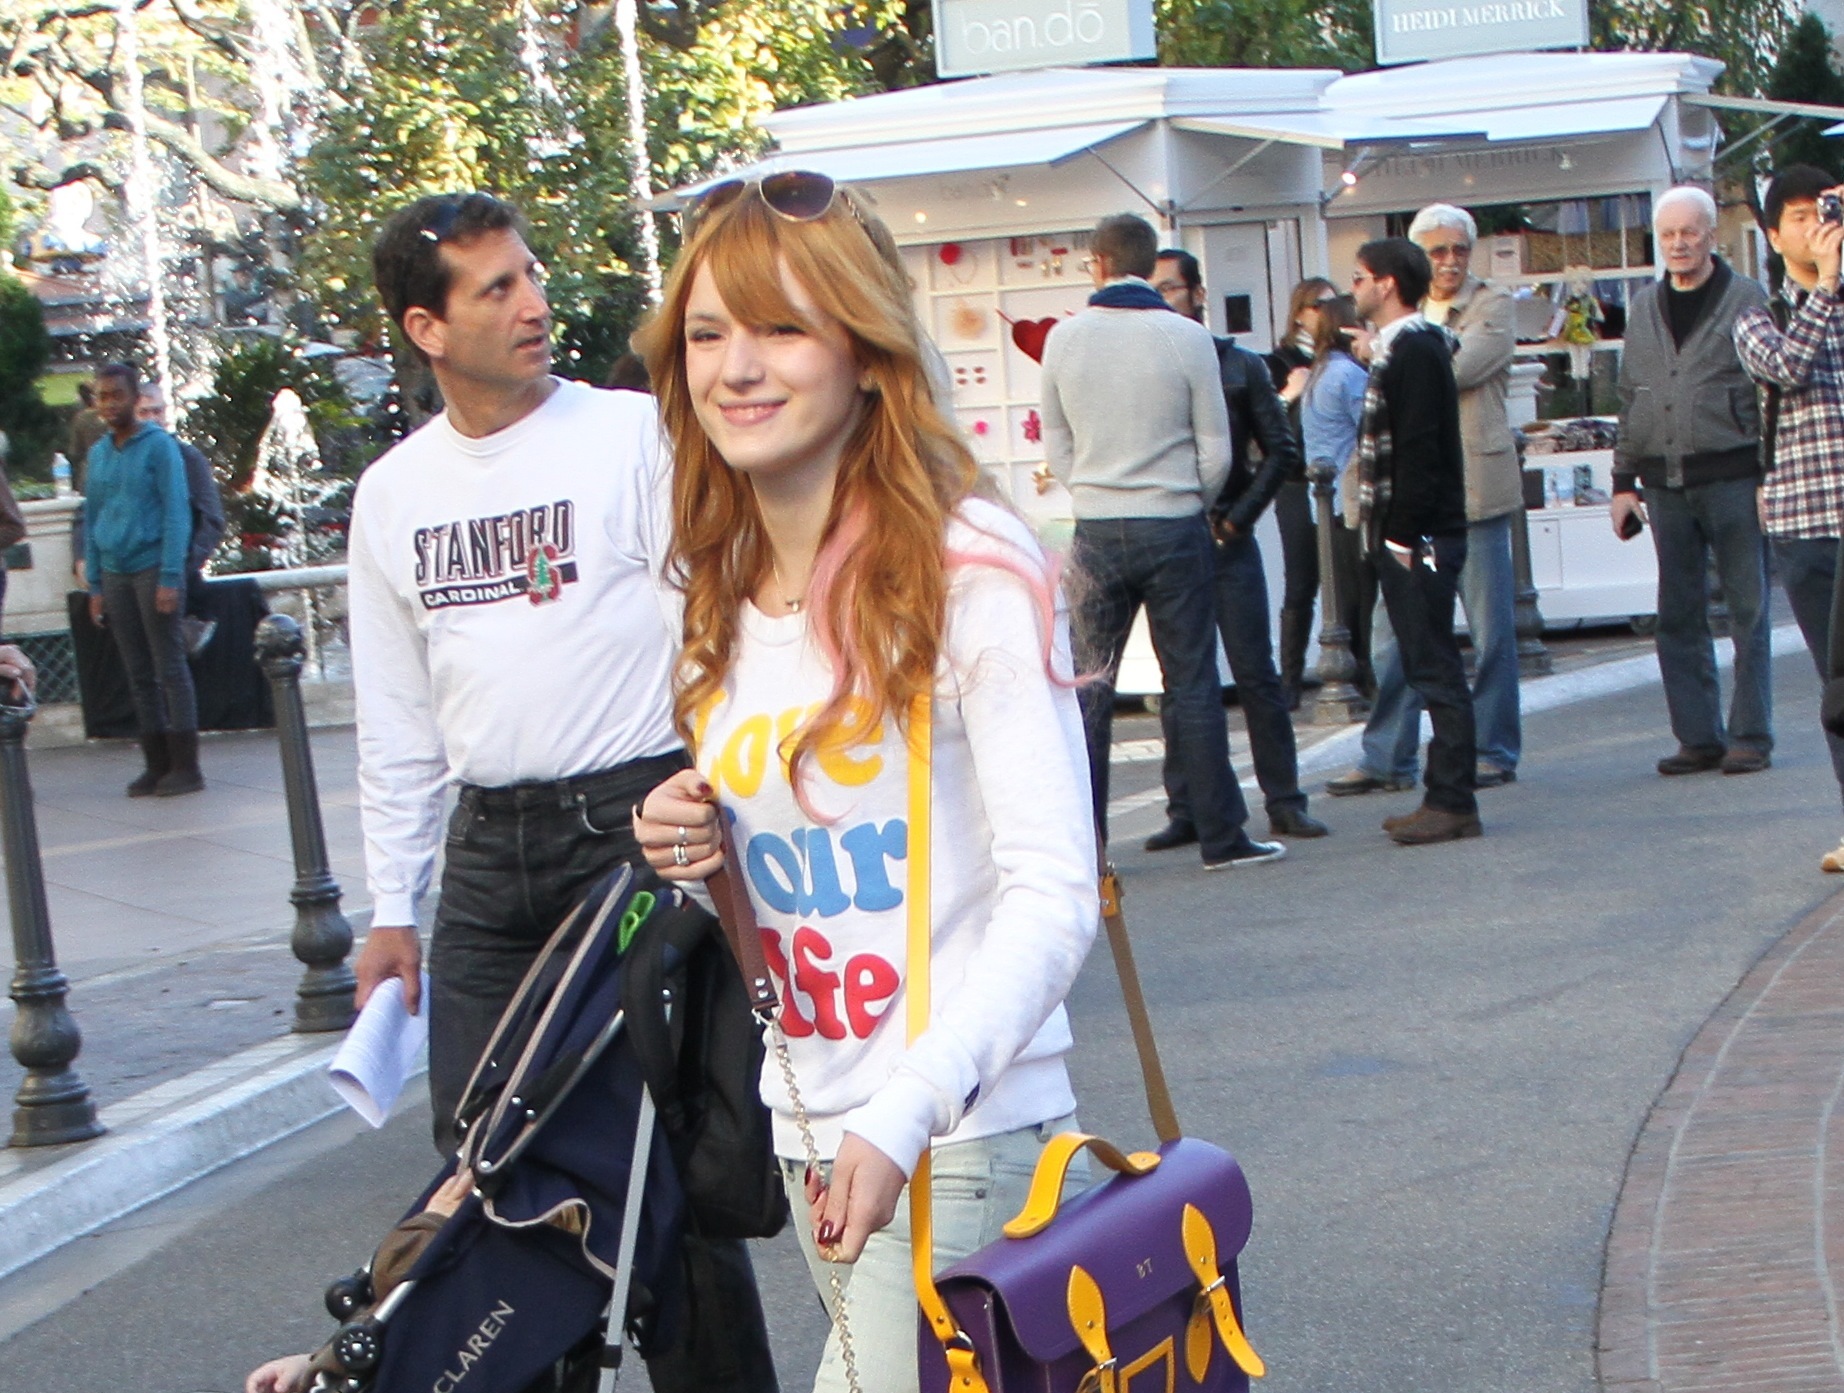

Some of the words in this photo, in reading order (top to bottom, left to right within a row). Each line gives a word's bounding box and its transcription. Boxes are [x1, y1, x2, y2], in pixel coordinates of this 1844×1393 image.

[1393, 7, 1457, 33] HEIDI
[1462, 0, 1565, 28] MERRICK
[414, 499, 576, 586] STANFORD
[425, 581, 522, 606] CARDINAL
[722, 806, 908, 918] our
